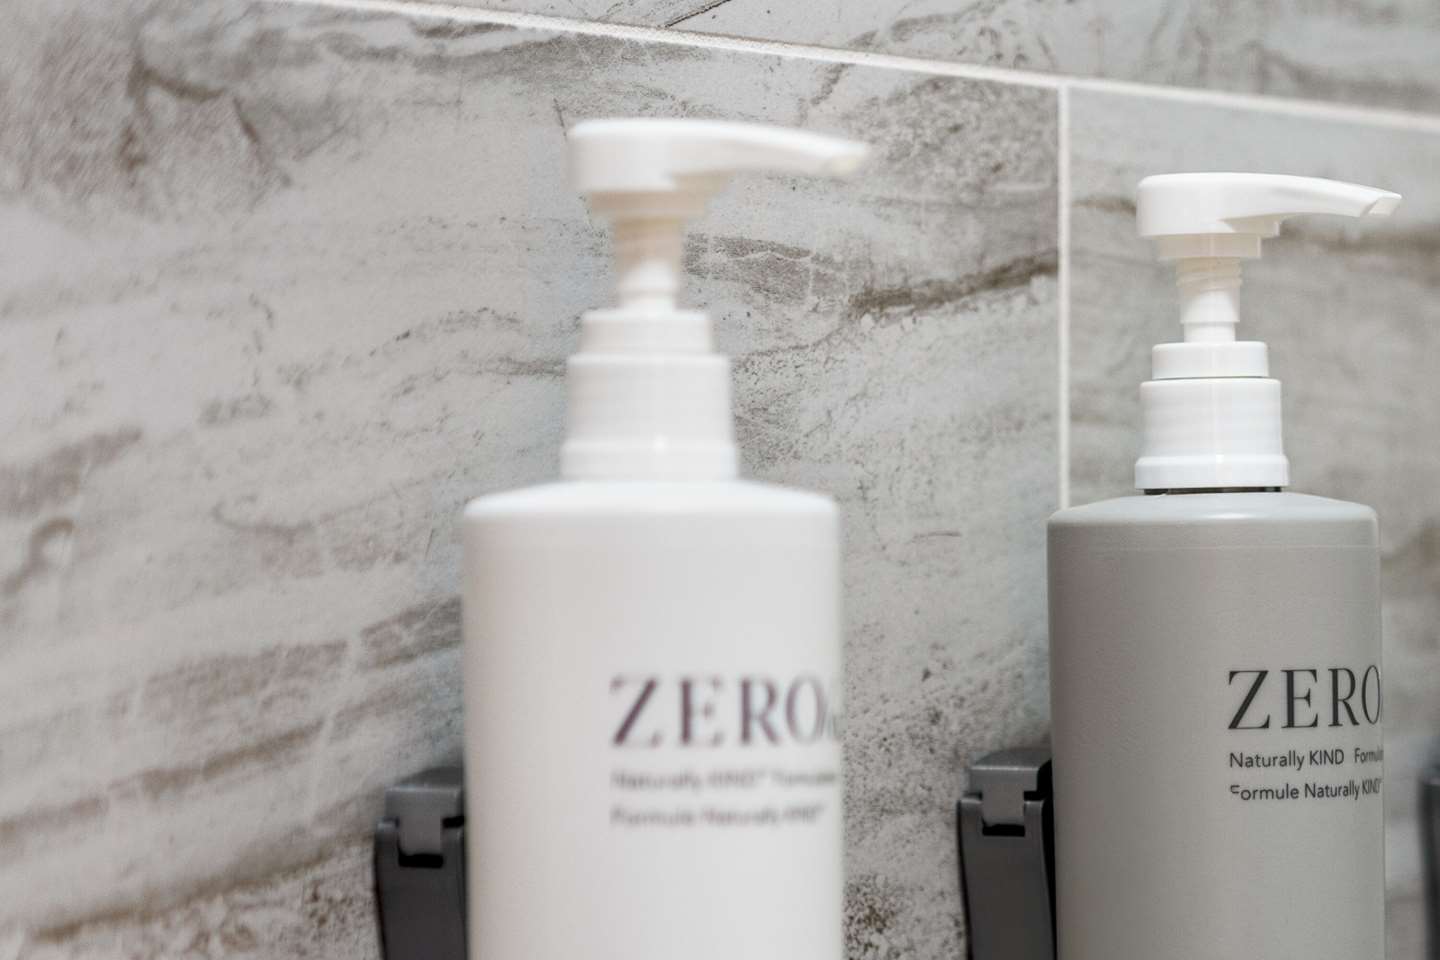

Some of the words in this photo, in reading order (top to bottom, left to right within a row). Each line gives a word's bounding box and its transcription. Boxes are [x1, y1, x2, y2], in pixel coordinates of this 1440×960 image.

[1228, 665, 1381, 730] ZERO
[1229, 750, 1305, 771] Naturally
[1309, 749, 1344, 766] KIND
[1304, 780, 1360, 801] Naturally
